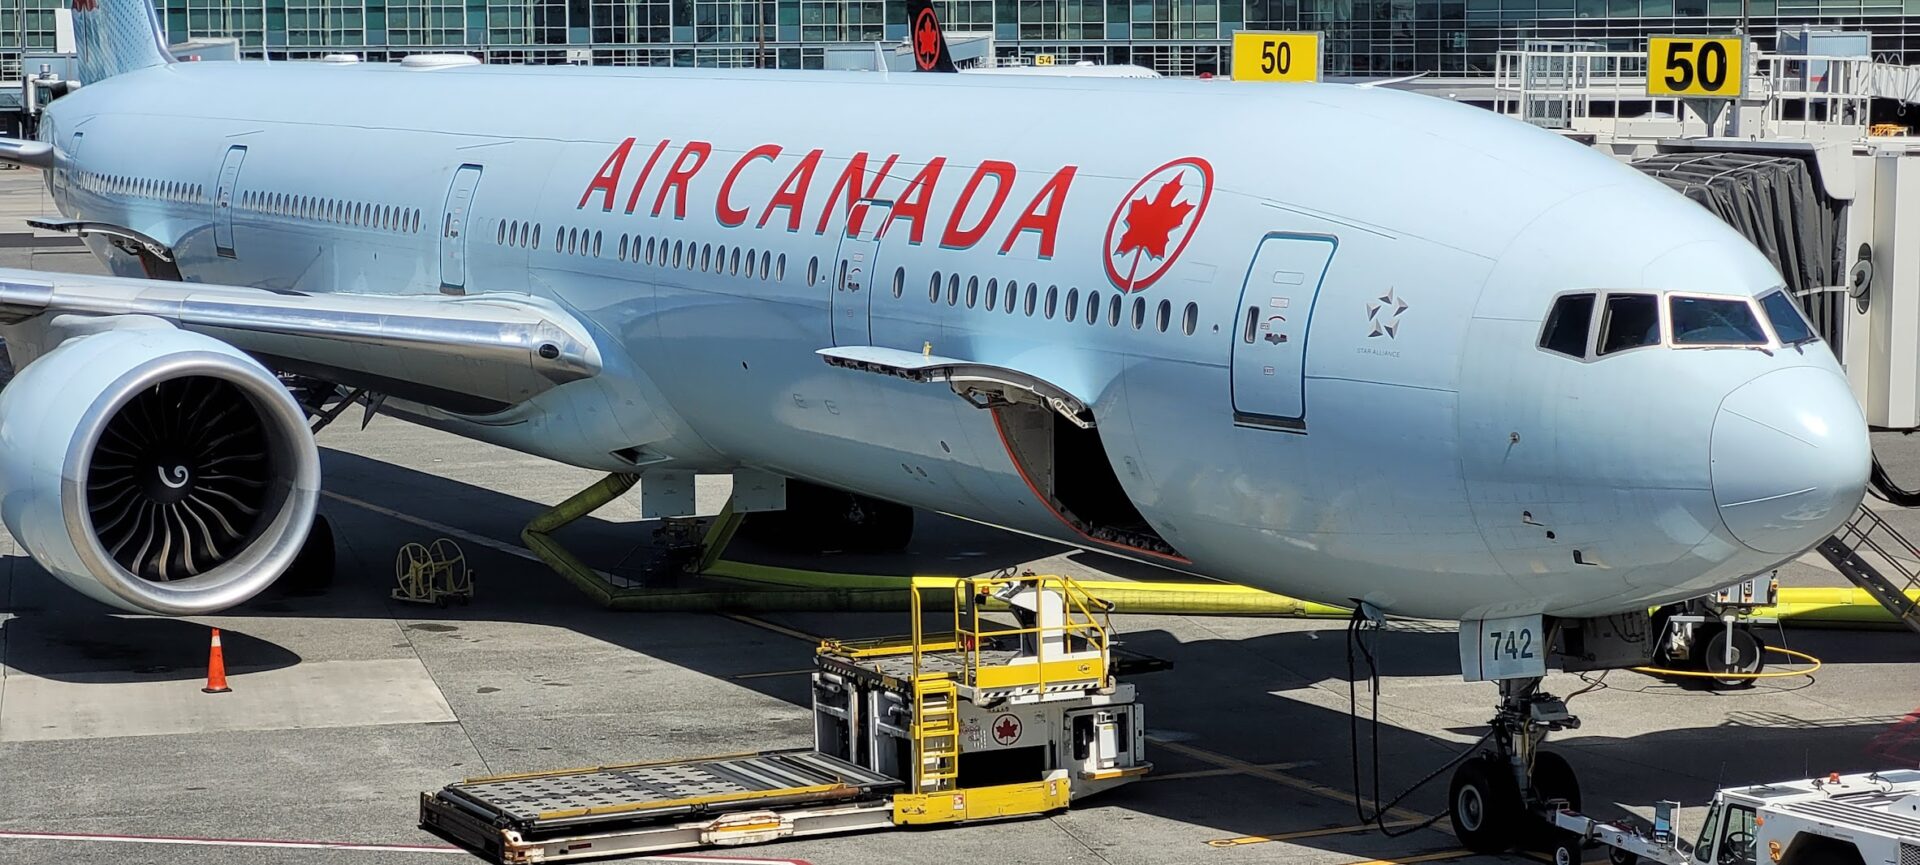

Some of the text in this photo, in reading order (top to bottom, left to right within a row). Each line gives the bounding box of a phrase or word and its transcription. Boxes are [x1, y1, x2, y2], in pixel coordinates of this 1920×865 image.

[1038, 56, 1052, 65] 54
[1261, 40, 1291, 75] 50
[1665, 42, 1728, 92] 50
[579, 137, 1078, 259] AIR CANADA
[1357, 347, 1400, 358] STAR ALLIANCE
[1490, 628, 1534, 661] 742
